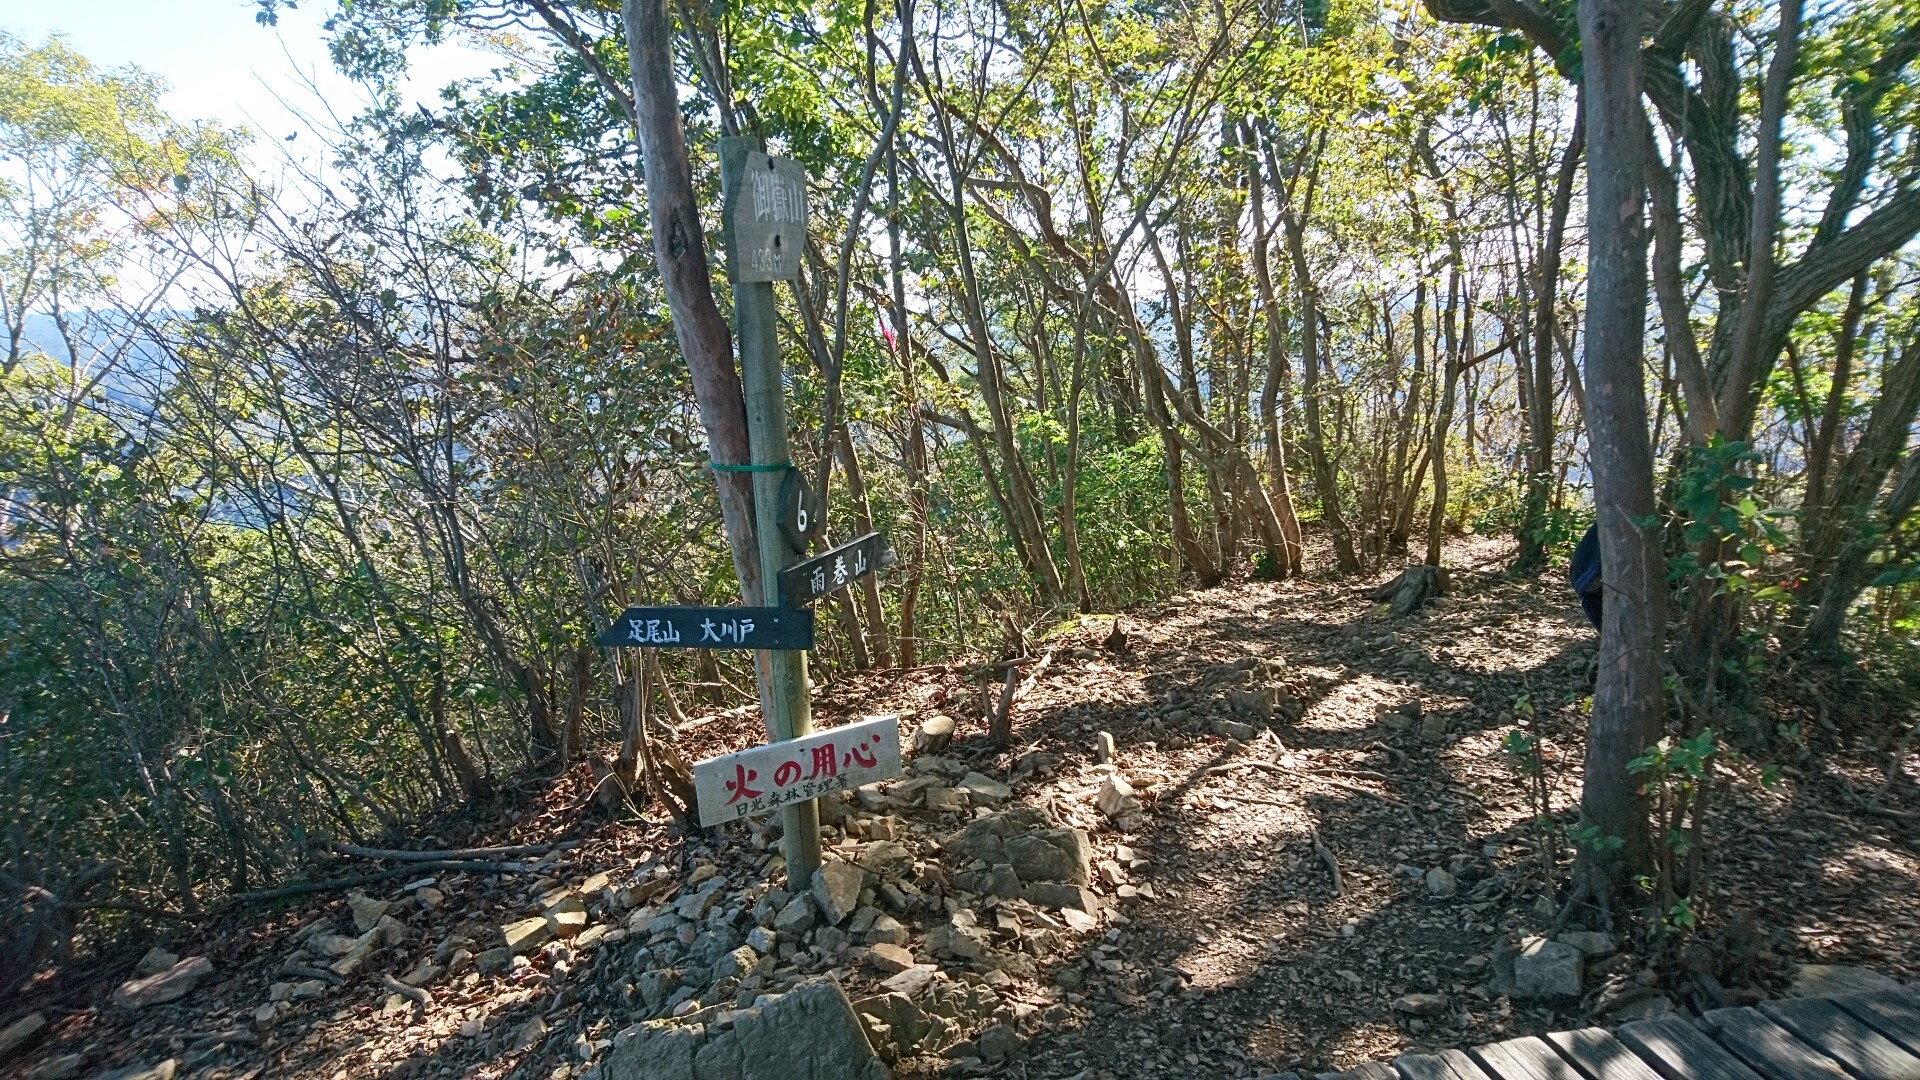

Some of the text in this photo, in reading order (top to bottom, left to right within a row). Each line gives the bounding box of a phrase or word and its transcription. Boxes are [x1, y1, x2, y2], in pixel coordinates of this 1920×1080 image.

[751, 169, 804, 224] 御嶽山
[797, 489, 808, 533] 6
[810, 549, 867, 594] 雨巻山
[626, 617, 755, 644] 足尾山 大川戸
[722, 734, 881, 806] 火の用心
[735, 773, 848, 817] 日光森林管理署
